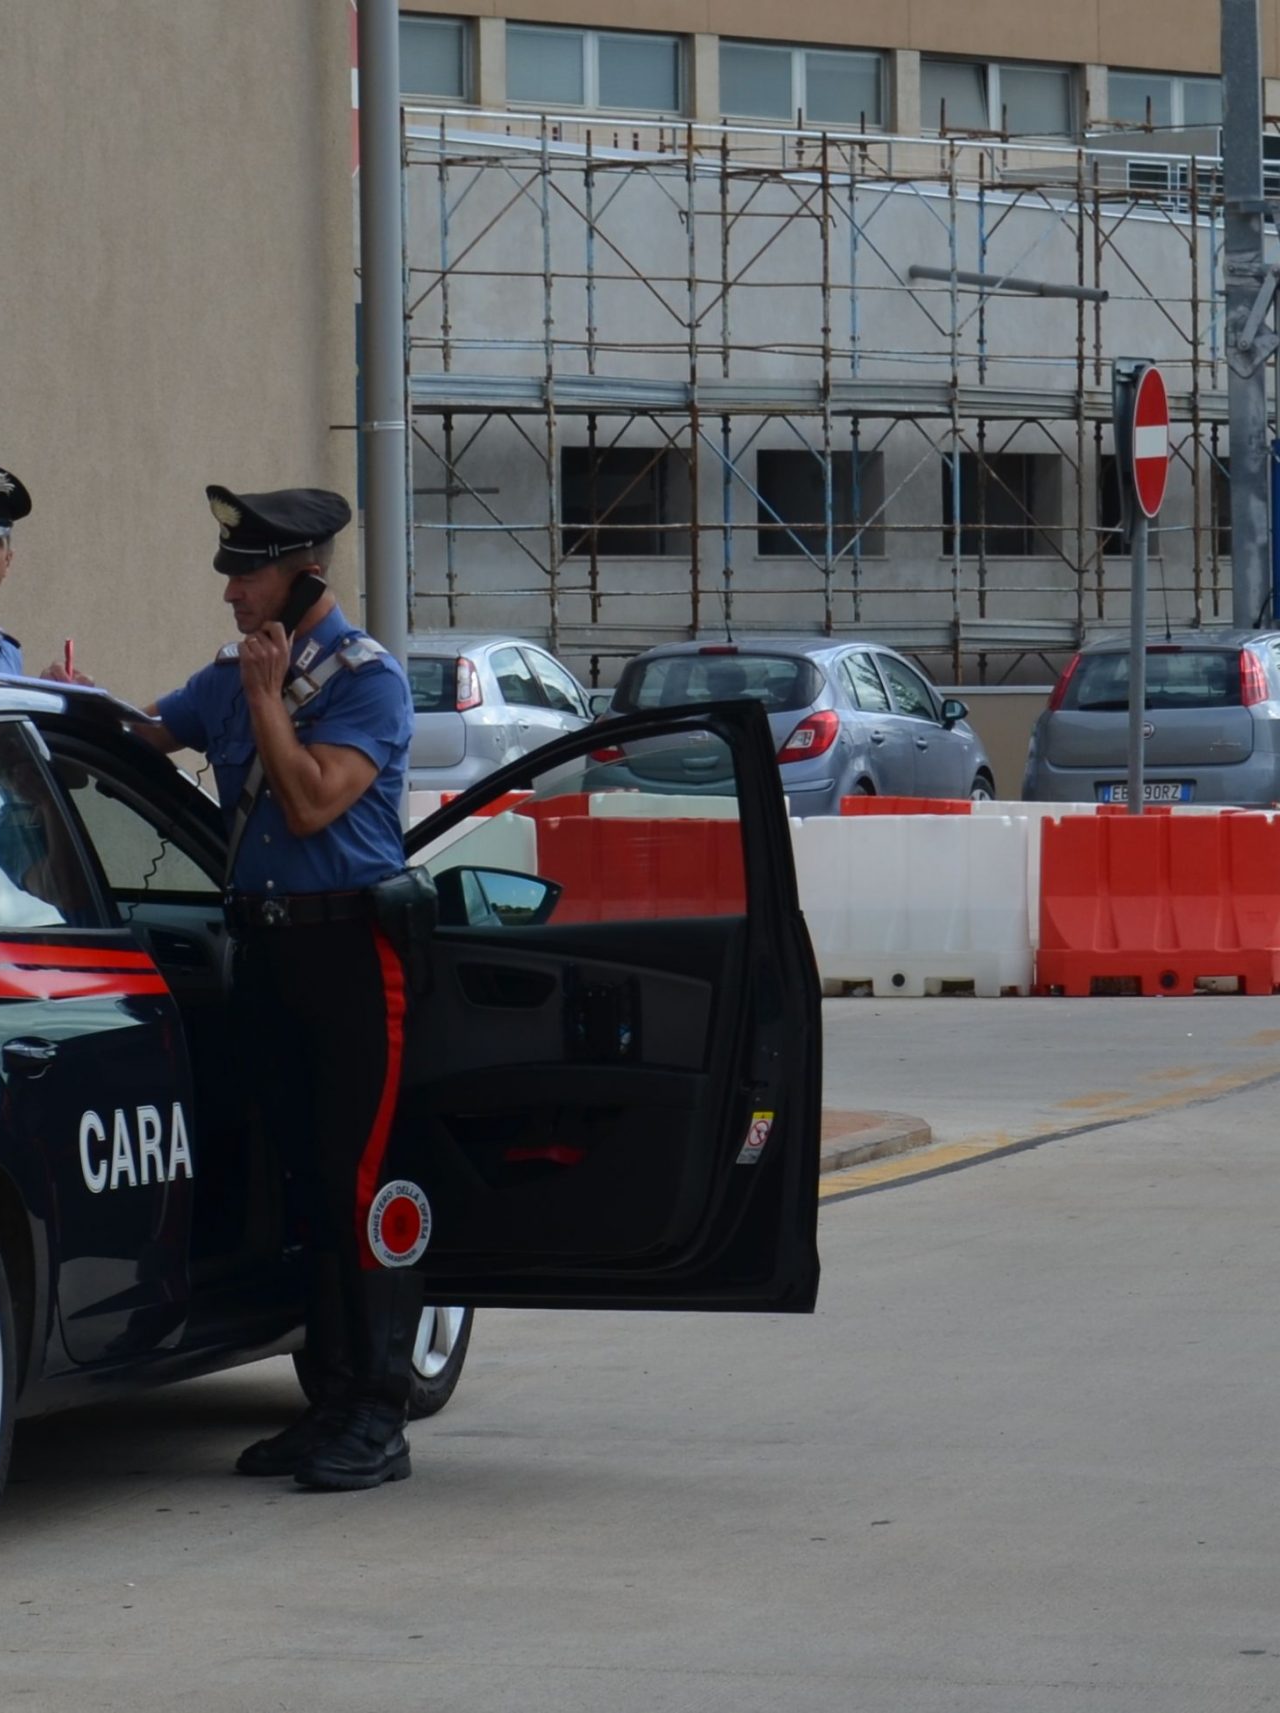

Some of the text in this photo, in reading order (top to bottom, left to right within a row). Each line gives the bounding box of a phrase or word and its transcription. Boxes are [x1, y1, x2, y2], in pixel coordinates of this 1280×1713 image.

[1112, 784, 1179, 800] EB90RZ
[79, 1102, 193, 1193] CARA
[396, 1185, 419, 1201] DELLA
